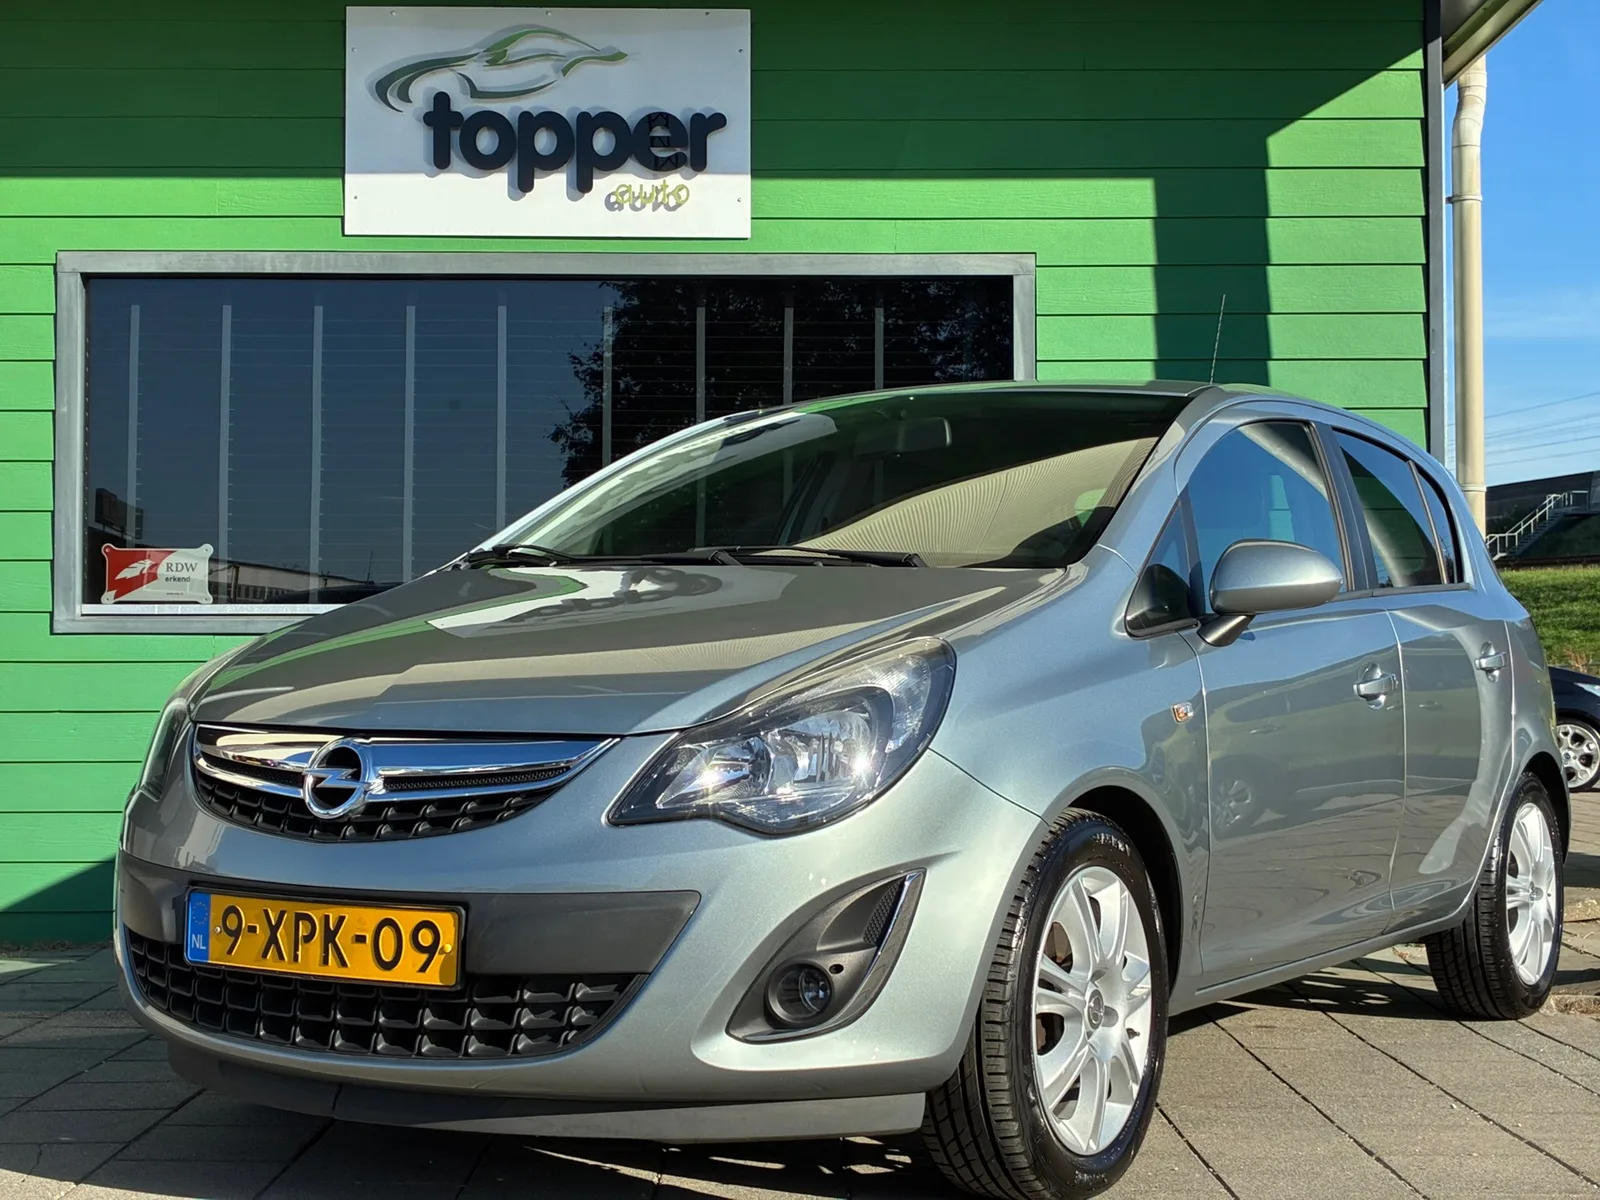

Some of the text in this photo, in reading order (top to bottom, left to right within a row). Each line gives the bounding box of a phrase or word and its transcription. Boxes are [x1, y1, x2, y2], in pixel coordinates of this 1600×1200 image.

[423, 91, 727, 193] topper
[615, 179, 690, 205] auto
[166, 562, 198, 573] RDW
[165, 575, 191, 583] erkend
[191, 932, 207, 950] NL
[220, 904, 442, 974] 9-XPK-09
